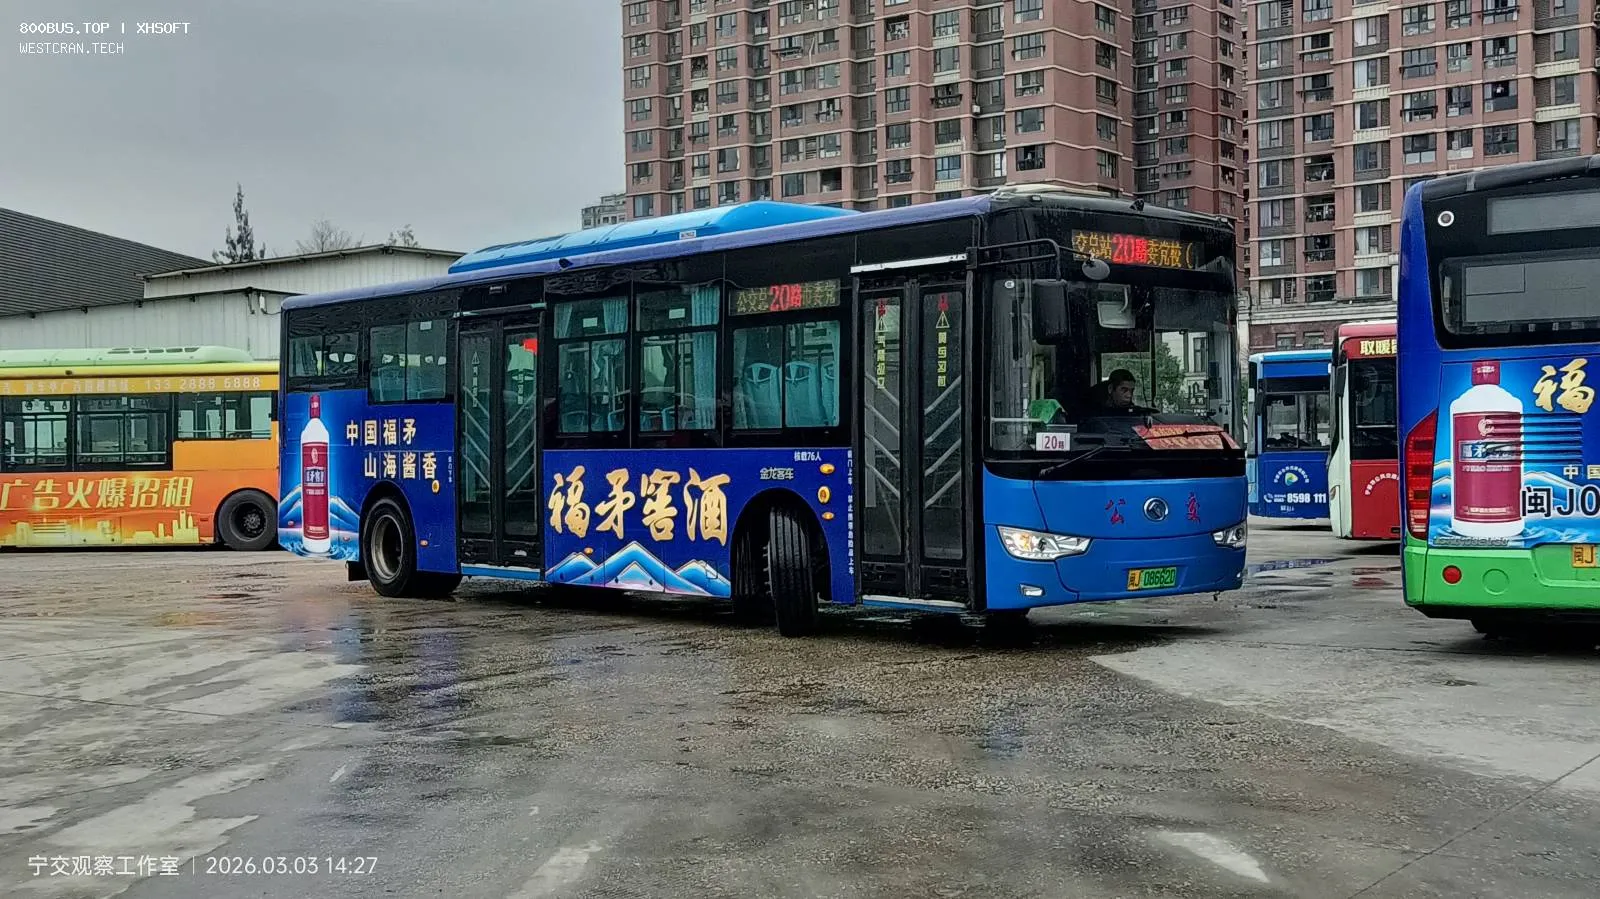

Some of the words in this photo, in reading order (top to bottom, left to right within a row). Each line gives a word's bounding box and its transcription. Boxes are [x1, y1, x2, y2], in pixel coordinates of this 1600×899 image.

[346, 419, 416, 447] 中国福矛
[364, 451, 437, 479] 山海酱香
[760, 467, 794, 480] 金龙客车
[0, 476, 194, 511] 广告火爆招租
[548, 465, 731, 546] 福矛窖酒
